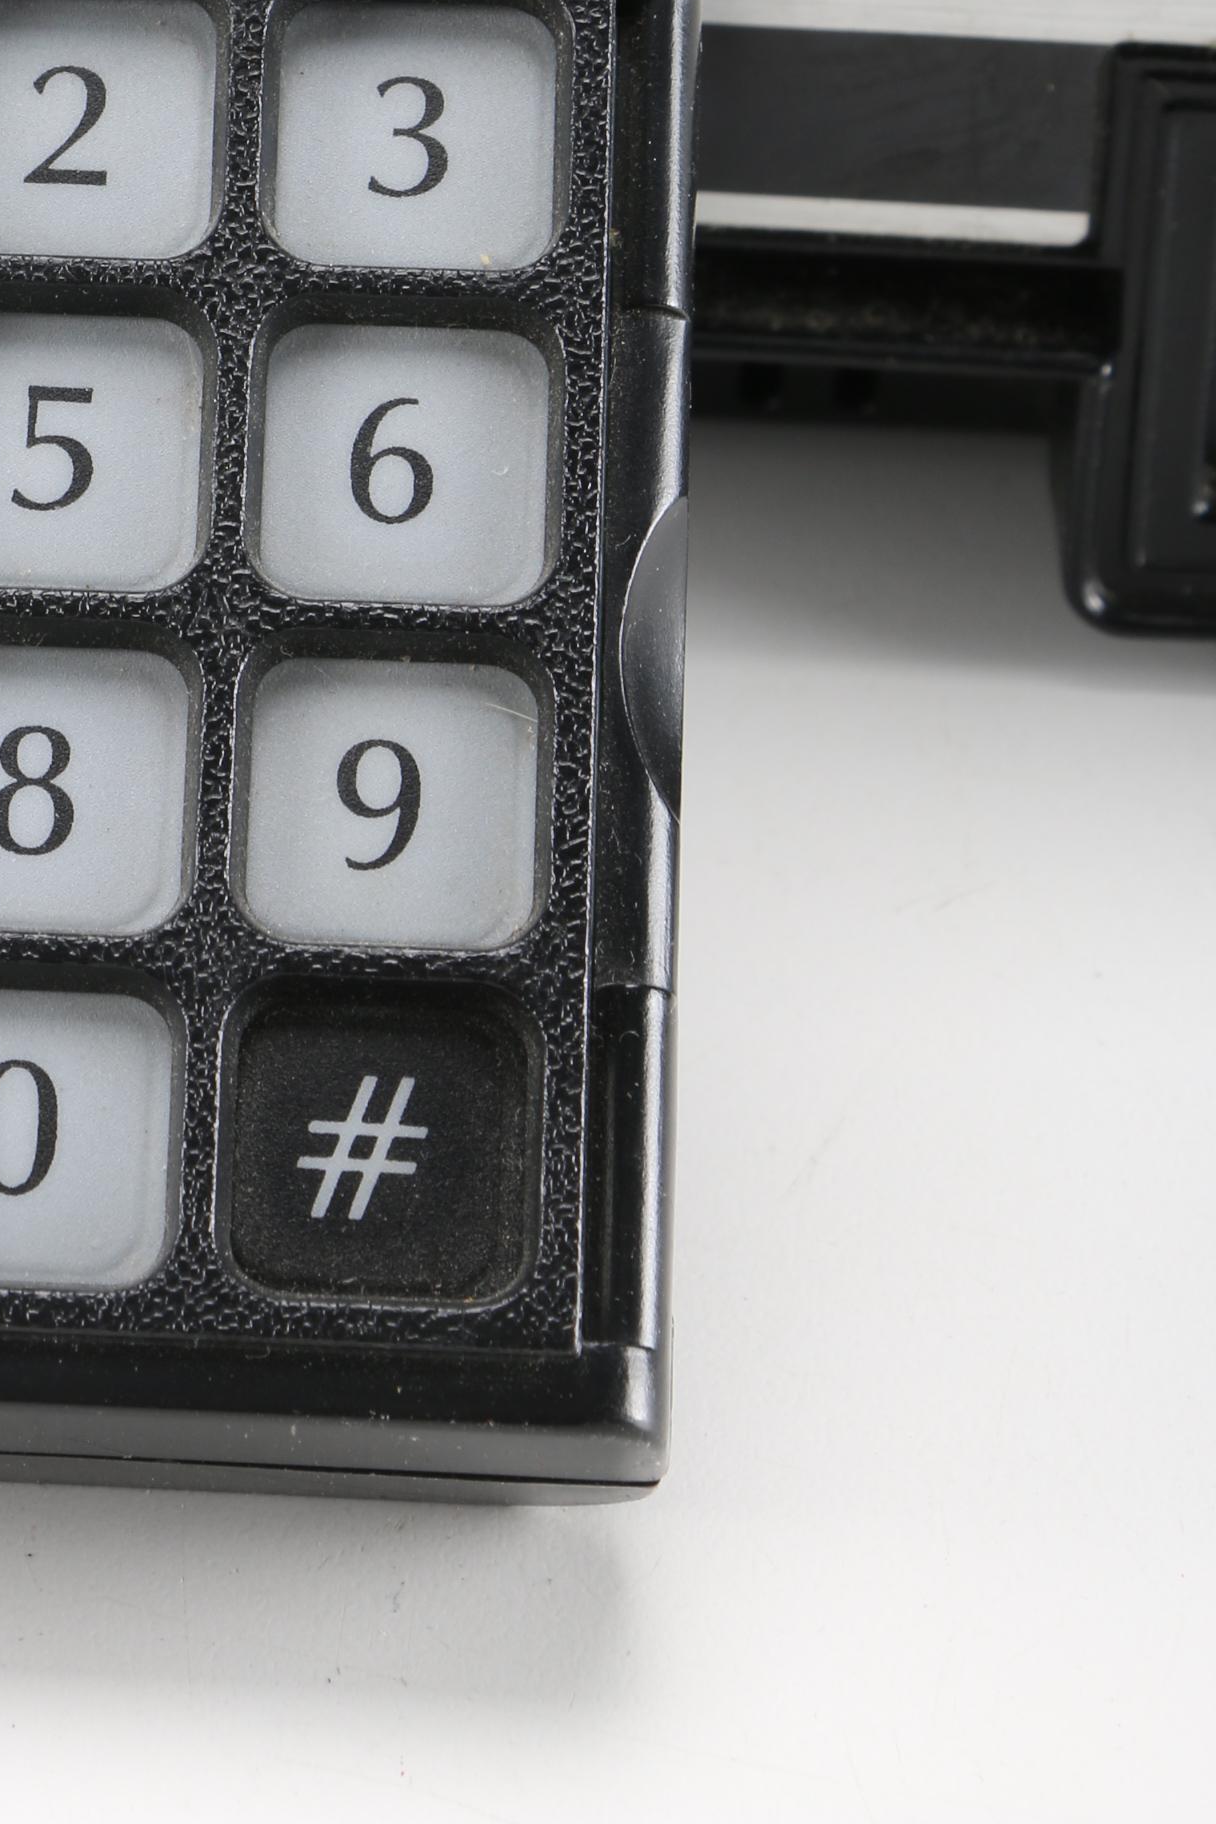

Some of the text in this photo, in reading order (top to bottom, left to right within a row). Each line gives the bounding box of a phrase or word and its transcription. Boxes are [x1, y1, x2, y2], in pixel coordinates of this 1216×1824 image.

[24, 66, 107, 185] 2
[369, 77, 448, 197] 3
[12, 386, 93, 511] 5
[351, 398, 433, 524] 6
[337, 740, 421, 870] 9
[297, 1076, 428, 1219] #
